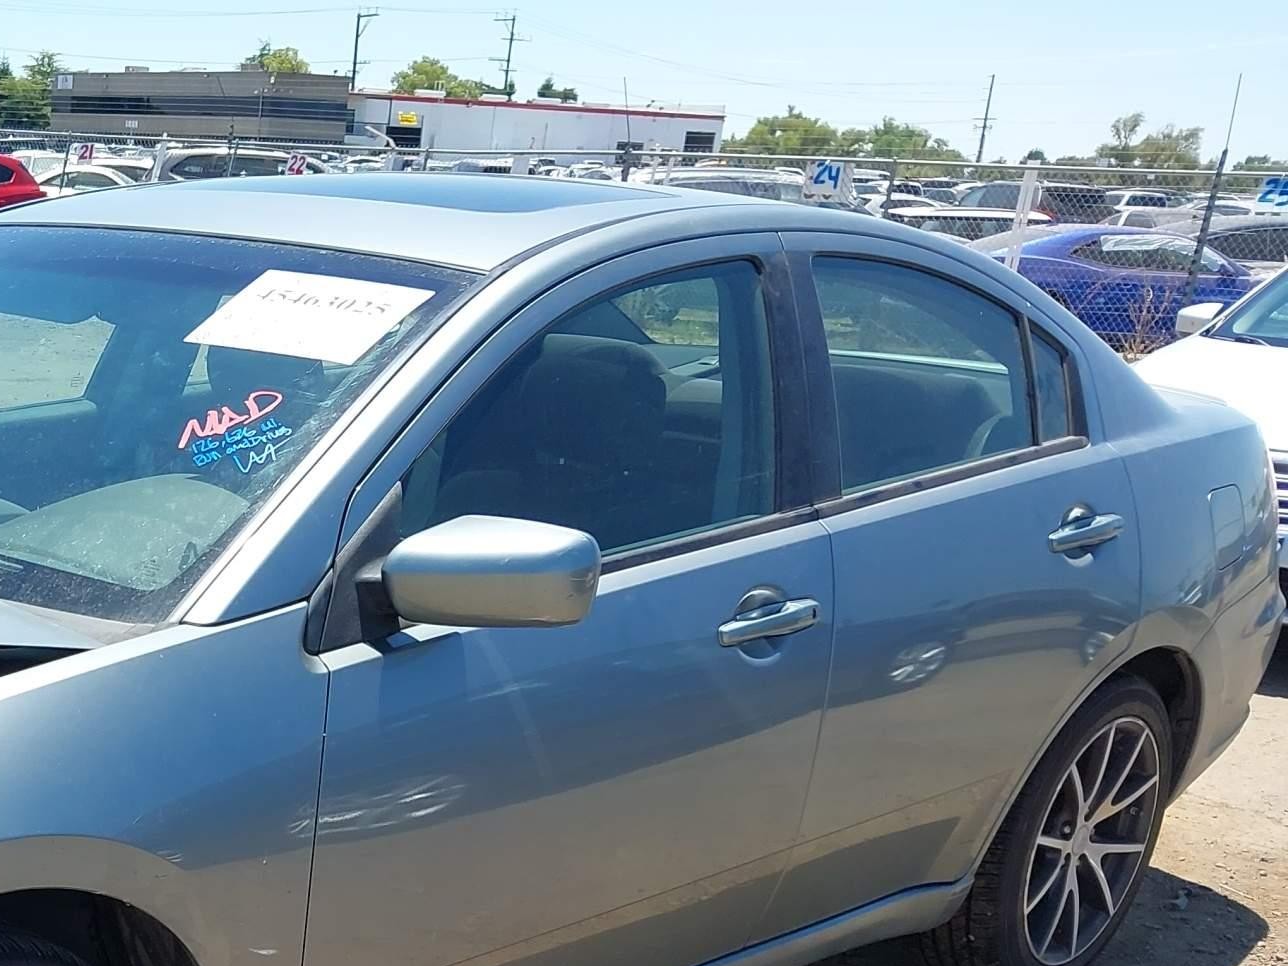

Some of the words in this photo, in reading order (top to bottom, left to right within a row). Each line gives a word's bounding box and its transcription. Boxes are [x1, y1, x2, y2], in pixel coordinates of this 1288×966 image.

[78, 143, 95, 161] 21
[287, 155, 307, 175] 22
[813, 161, 841, 190] 24
